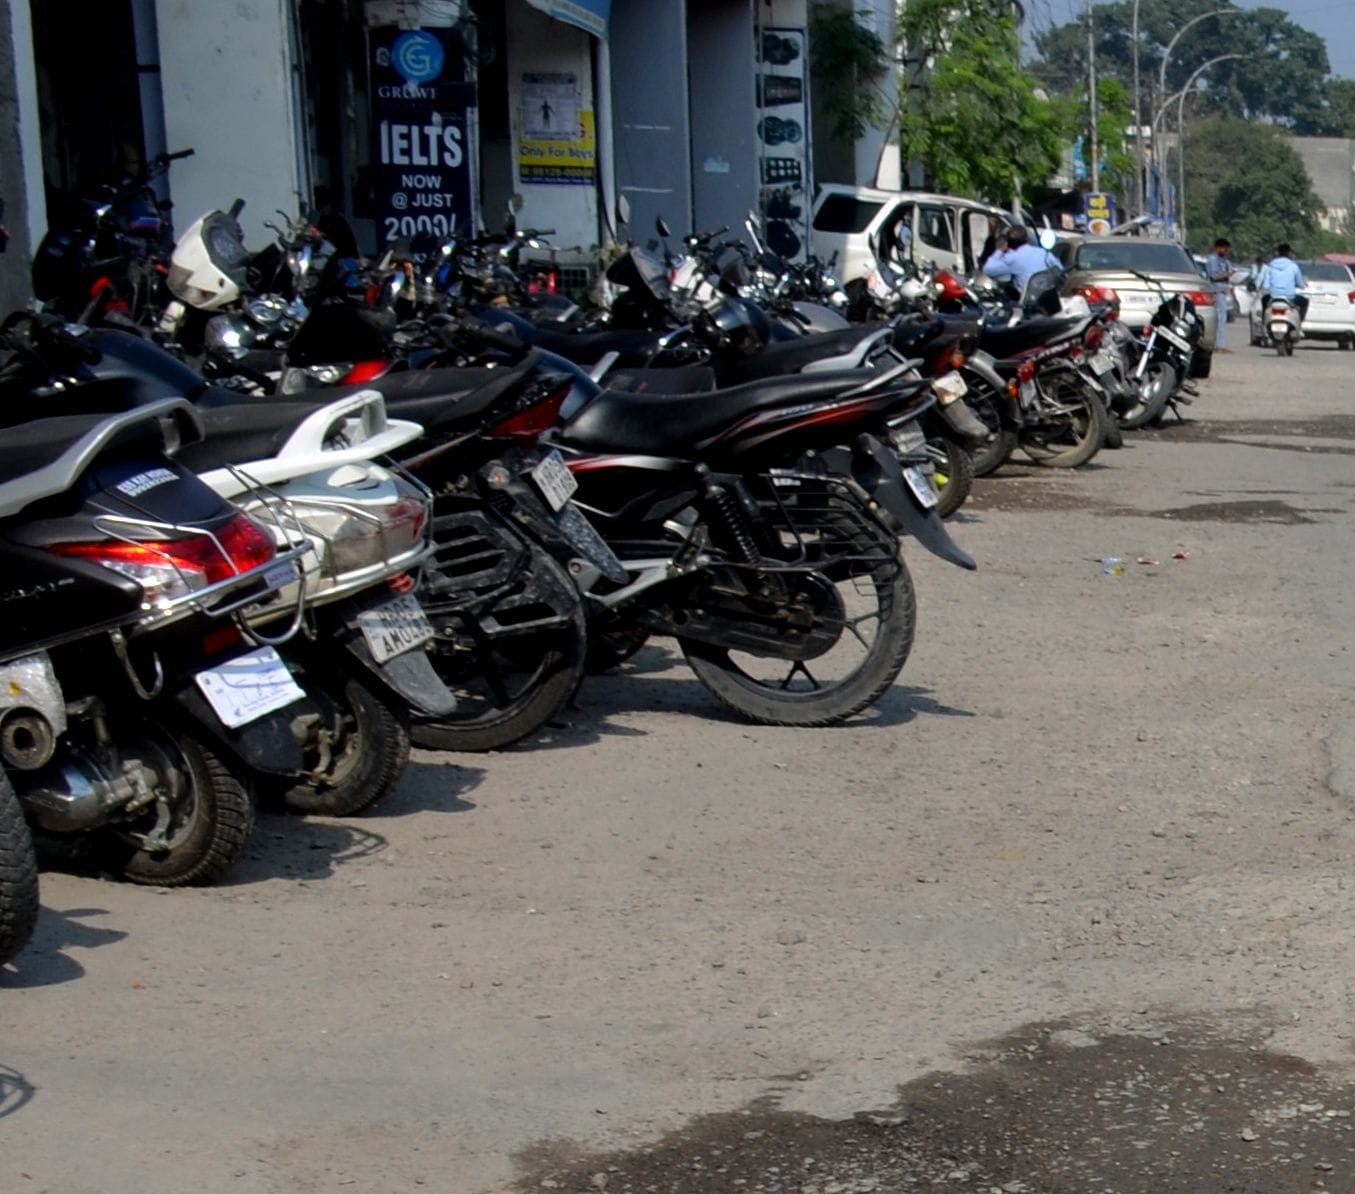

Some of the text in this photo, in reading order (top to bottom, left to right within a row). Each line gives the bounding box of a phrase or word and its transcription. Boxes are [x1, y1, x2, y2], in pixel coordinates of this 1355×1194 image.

[380, 121, 463, 168] IELTS
[401, 173, 442, 189] NOW
[411, 193, 454, 207] JUST
